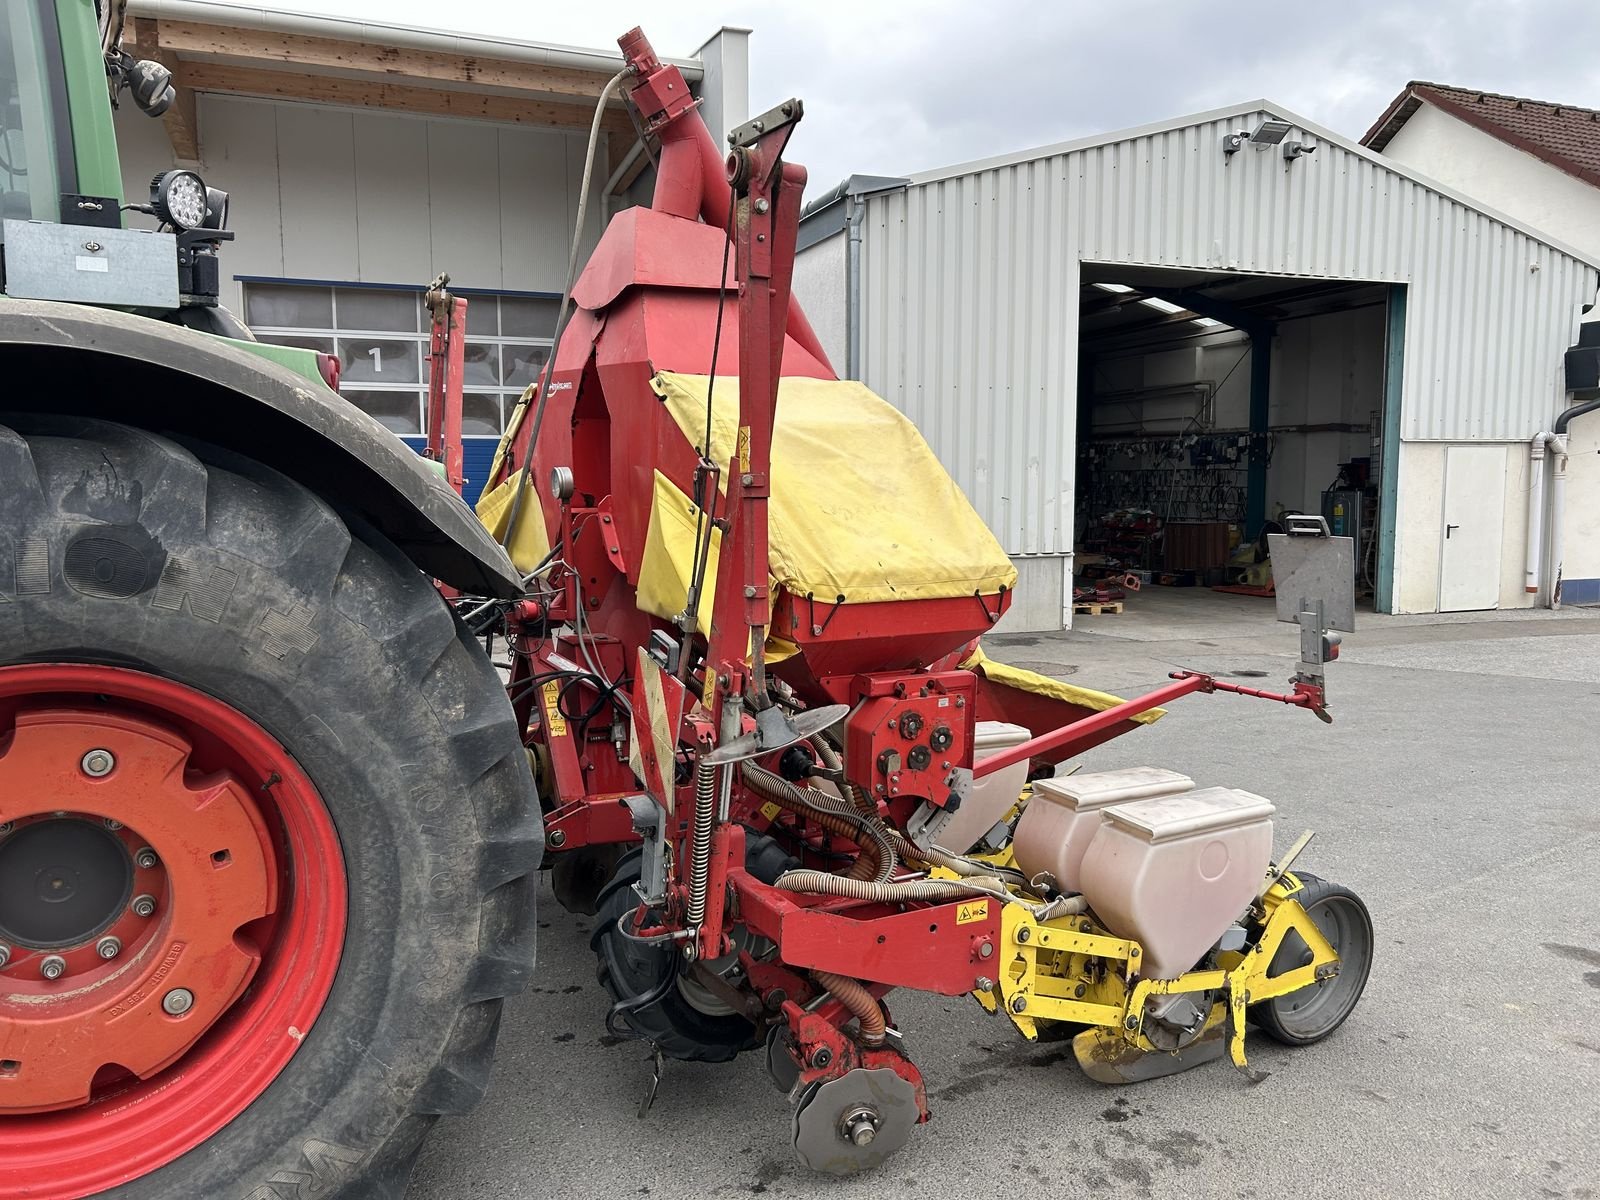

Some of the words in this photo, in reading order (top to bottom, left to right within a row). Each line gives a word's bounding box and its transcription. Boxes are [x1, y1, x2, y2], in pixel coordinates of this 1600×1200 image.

[368, 347, 382, 372] 1
[0, 537, 239, 623] ION
[109, 1003, 126, 1017] KG
